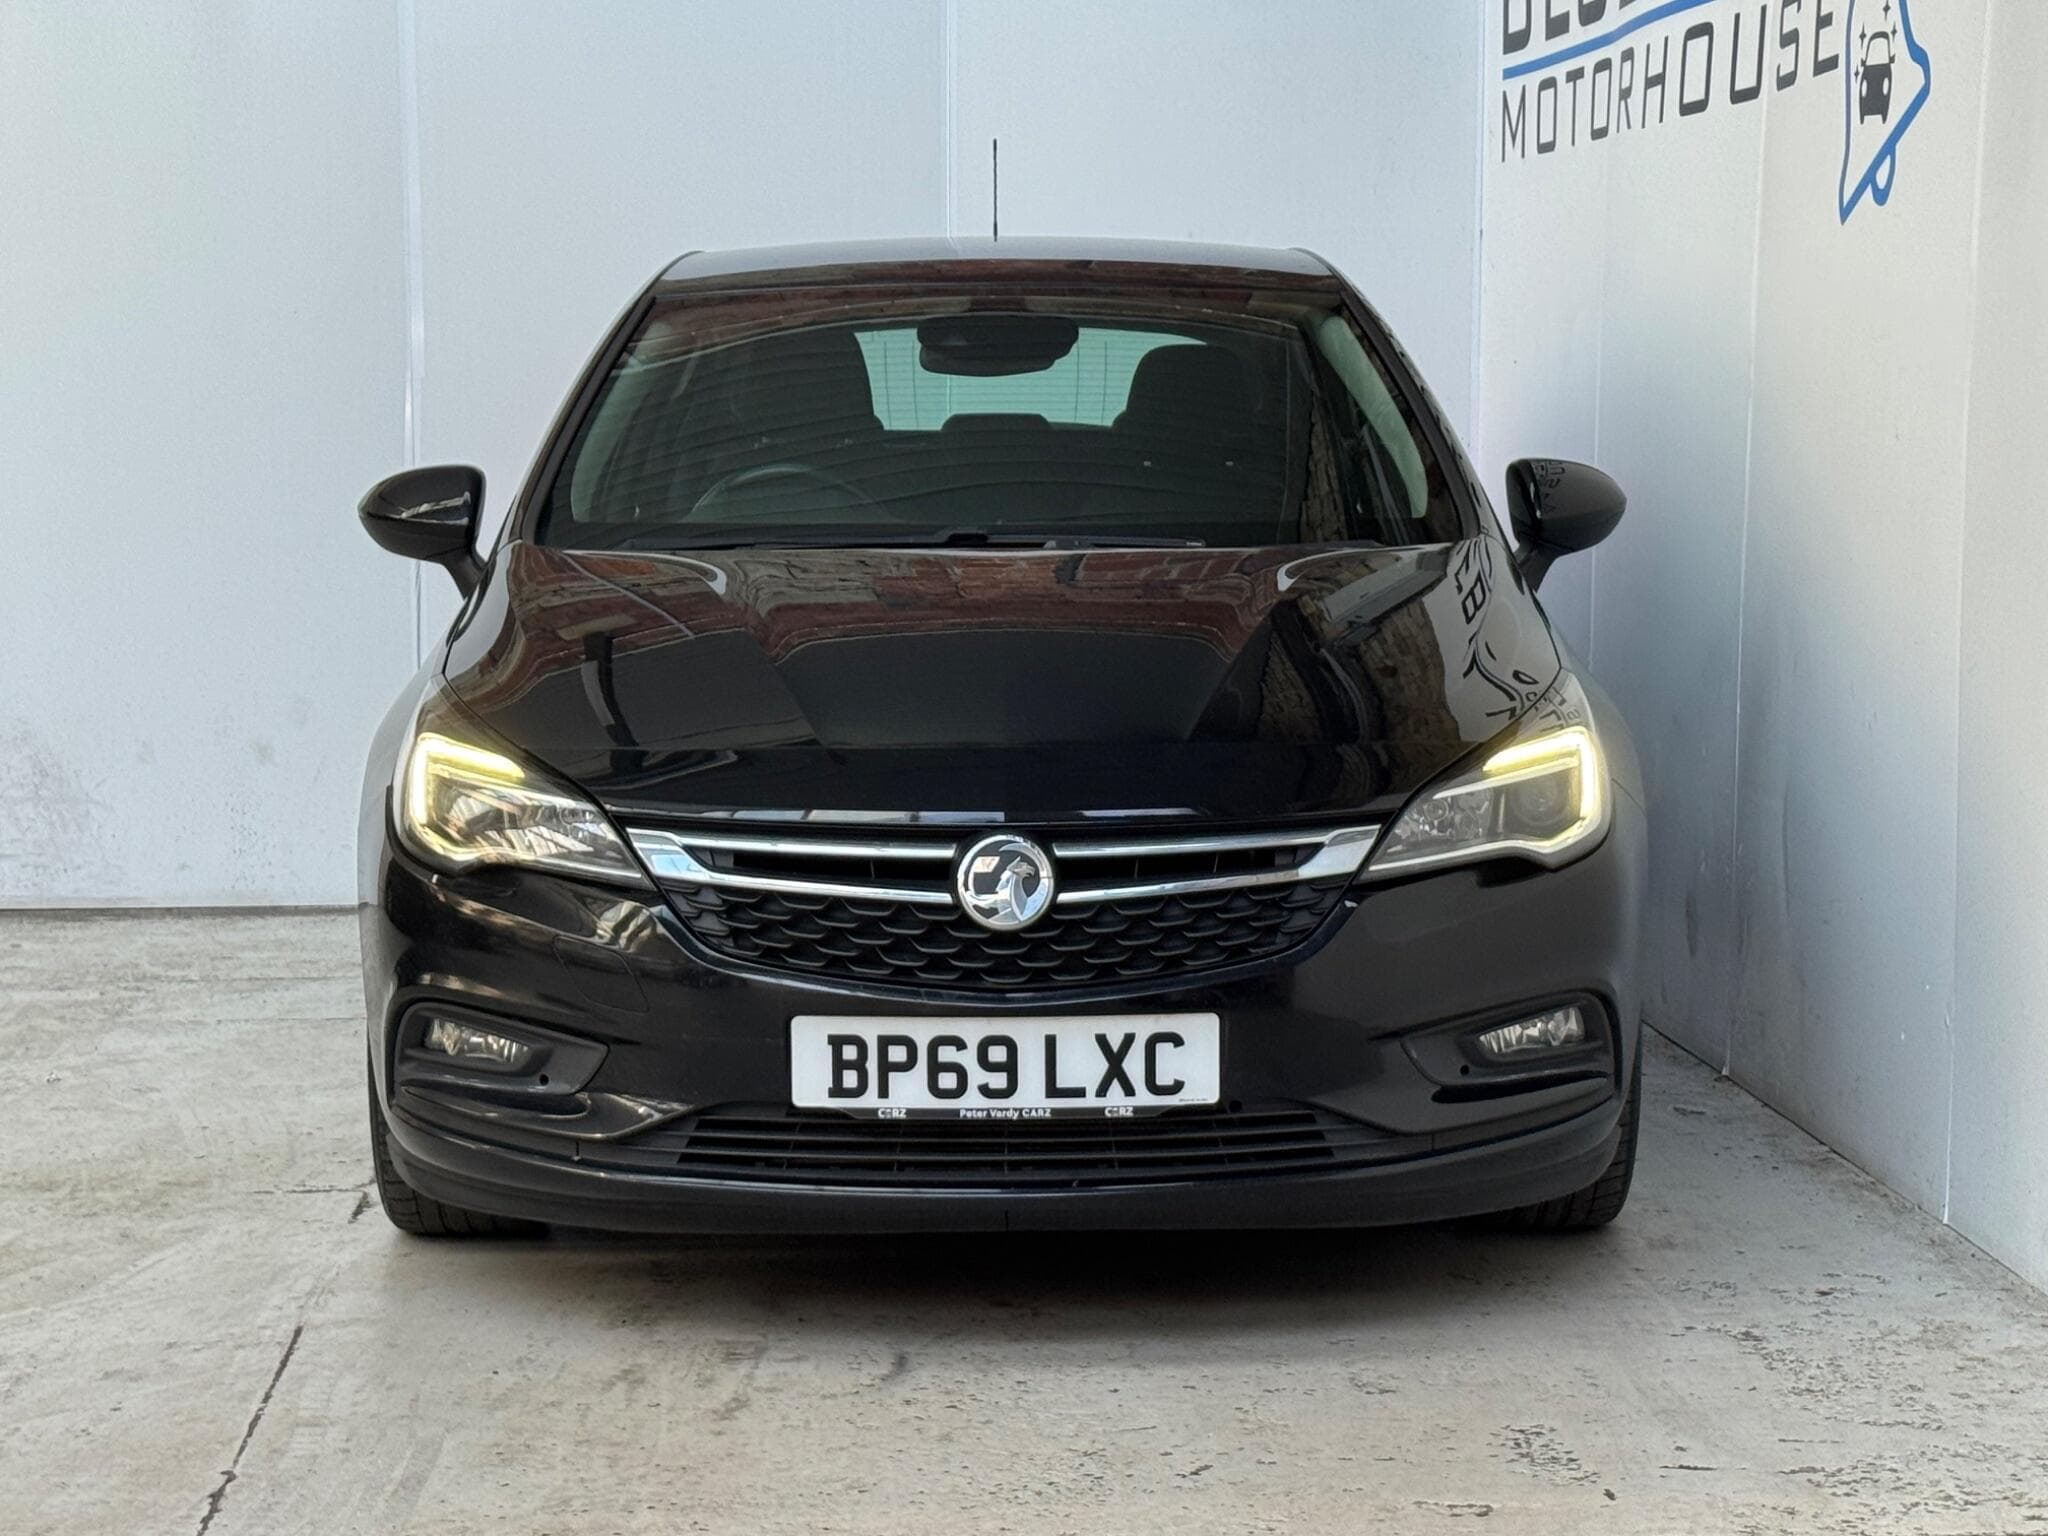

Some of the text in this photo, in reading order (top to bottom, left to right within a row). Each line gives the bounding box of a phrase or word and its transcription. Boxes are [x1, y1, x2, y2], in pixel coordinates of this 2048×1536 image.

[1501, 0, 1839, 163] MOTORHOUSE
[827, 1031, 1186, 1099] BP69 LXC
[959, 1107, 1052, 1120] Peter Vardy CARZ
